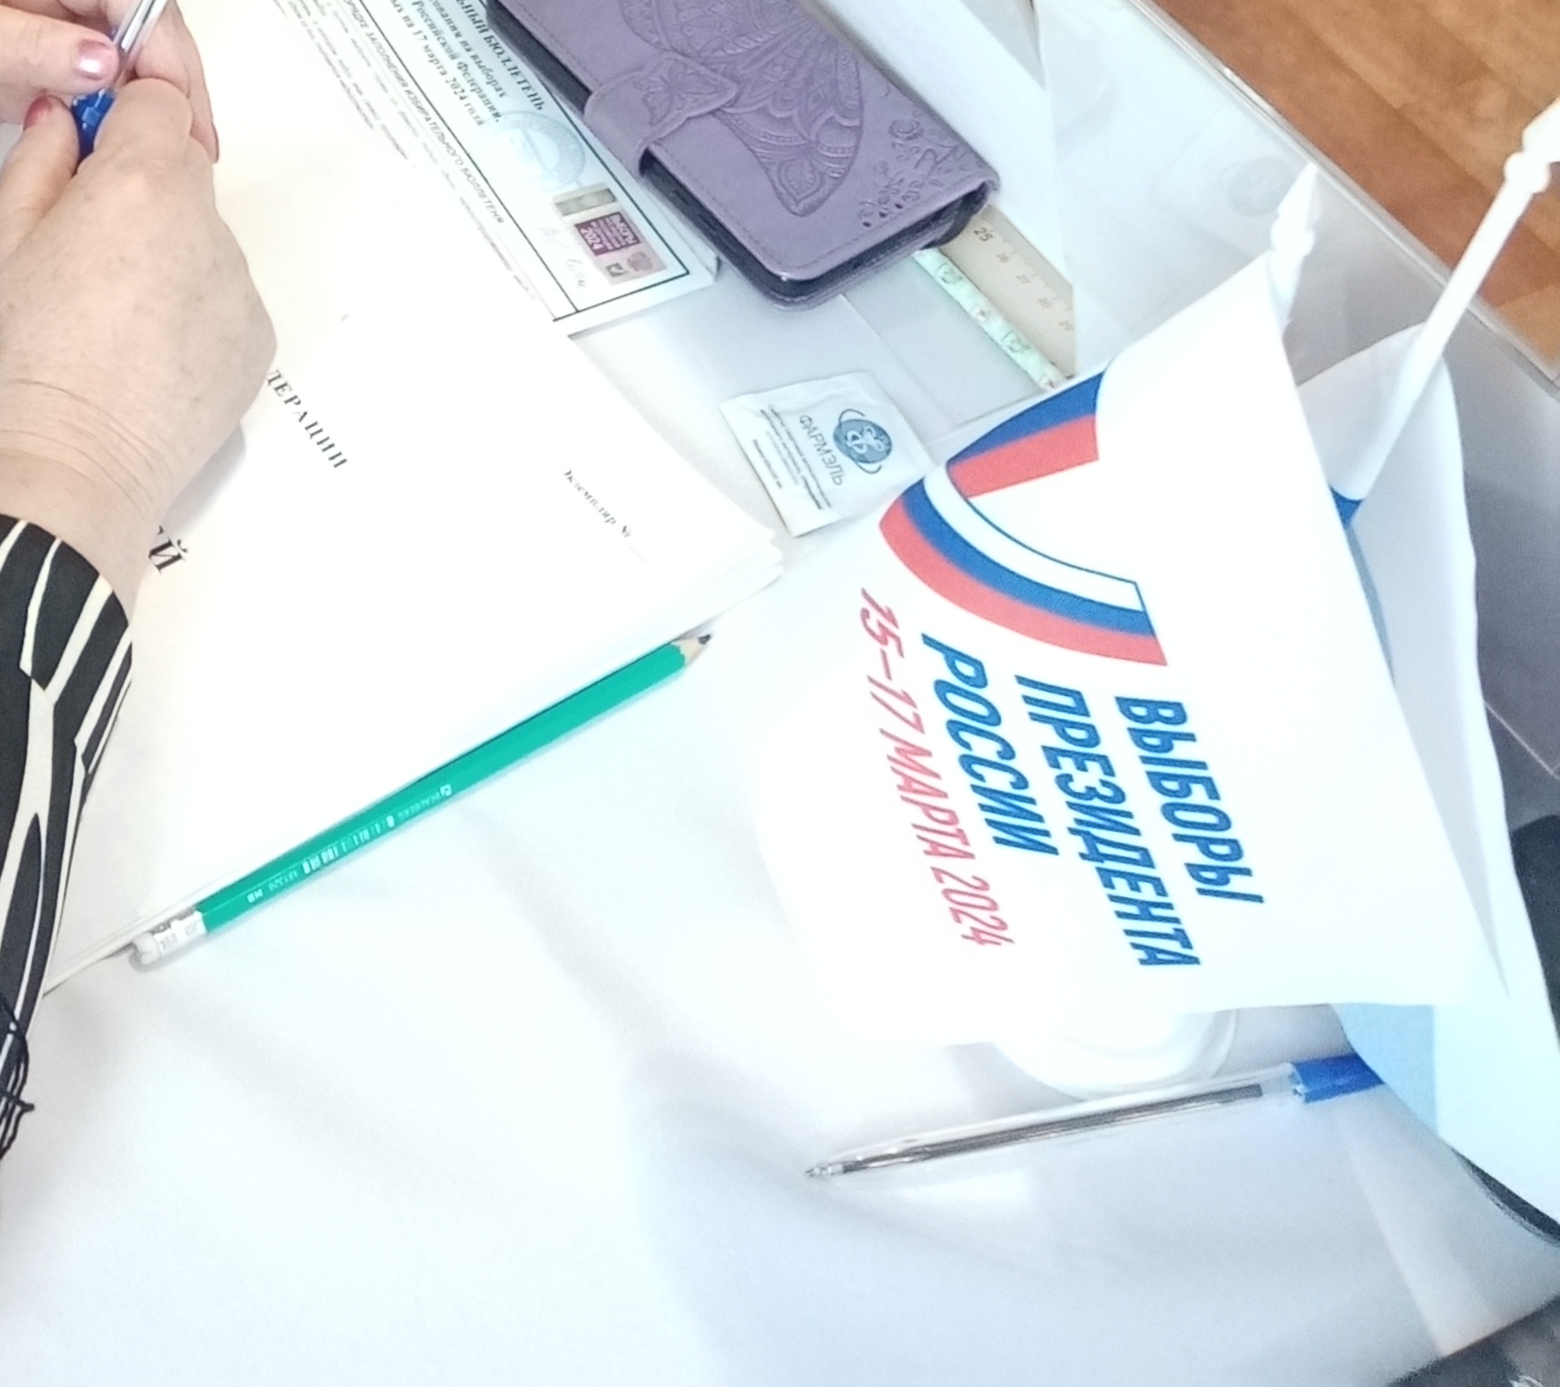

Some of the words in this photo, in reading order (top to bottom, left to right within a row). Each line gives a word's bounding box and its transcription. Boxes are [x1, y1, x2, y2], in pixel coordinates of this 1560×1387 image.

[411, 28, 429, 41] 17
[443, 76, 469, 101] 2024
[482, 33, 545, 111] БЮЛЛЕТЕНЬ
[973, 227, 994, 243] 25
[266, 369, 348, 469] ДЕРАЦИИ
[797, 413, 844, 486] ФАРМЭЛЬ
[923, 635, 1059, 856] РОССИИ
[879, 728, 976, 859] МАРТА
[930, 866, 1014, 945] 2024
[1016, 676, 1201, 966] ПРЕЗИДЕНТА
[1115, 696, 1263, 904] ВЫБОРЫ
